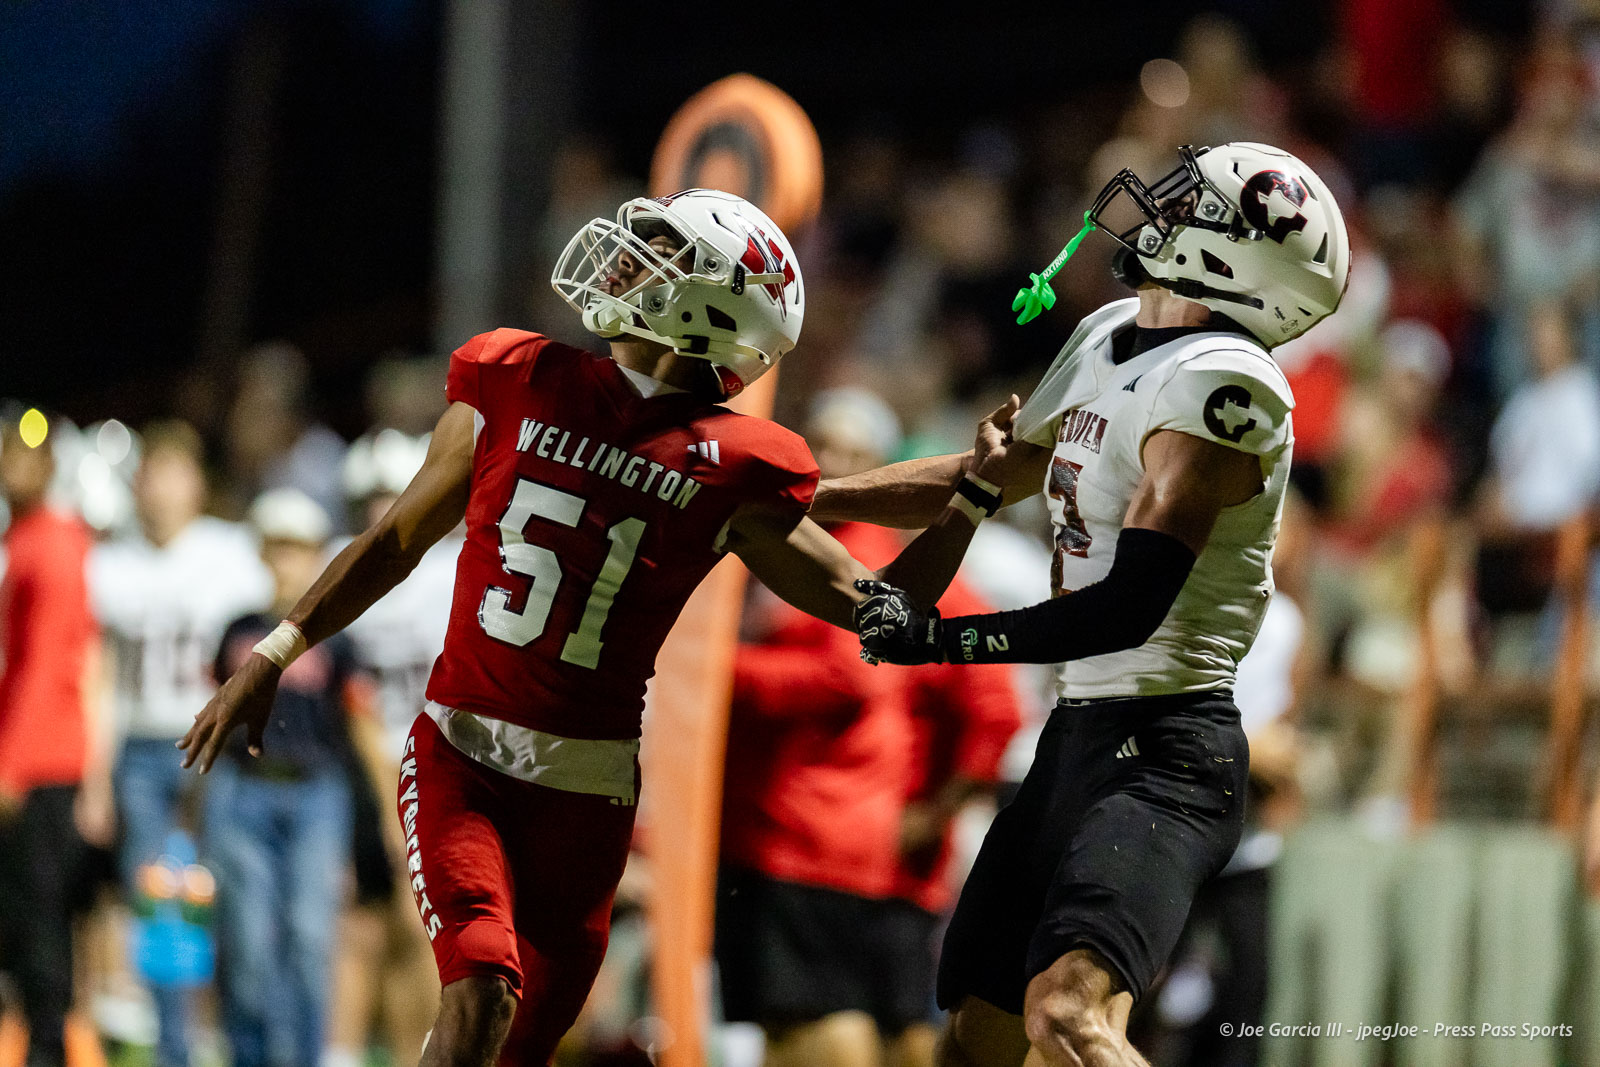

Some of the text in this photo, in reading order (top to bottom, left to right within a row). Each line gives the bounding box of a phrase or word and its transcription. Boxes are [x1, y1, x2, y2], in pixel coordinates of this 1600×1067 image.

[1042, 249, 1069, 280] NXTRND
[516, 417, 701, 510] WELLINGTON
[478, 477, 647, 670] 51
[961, 632, 974, 661] LZRD
[986, 633, 1009, 652] 2
